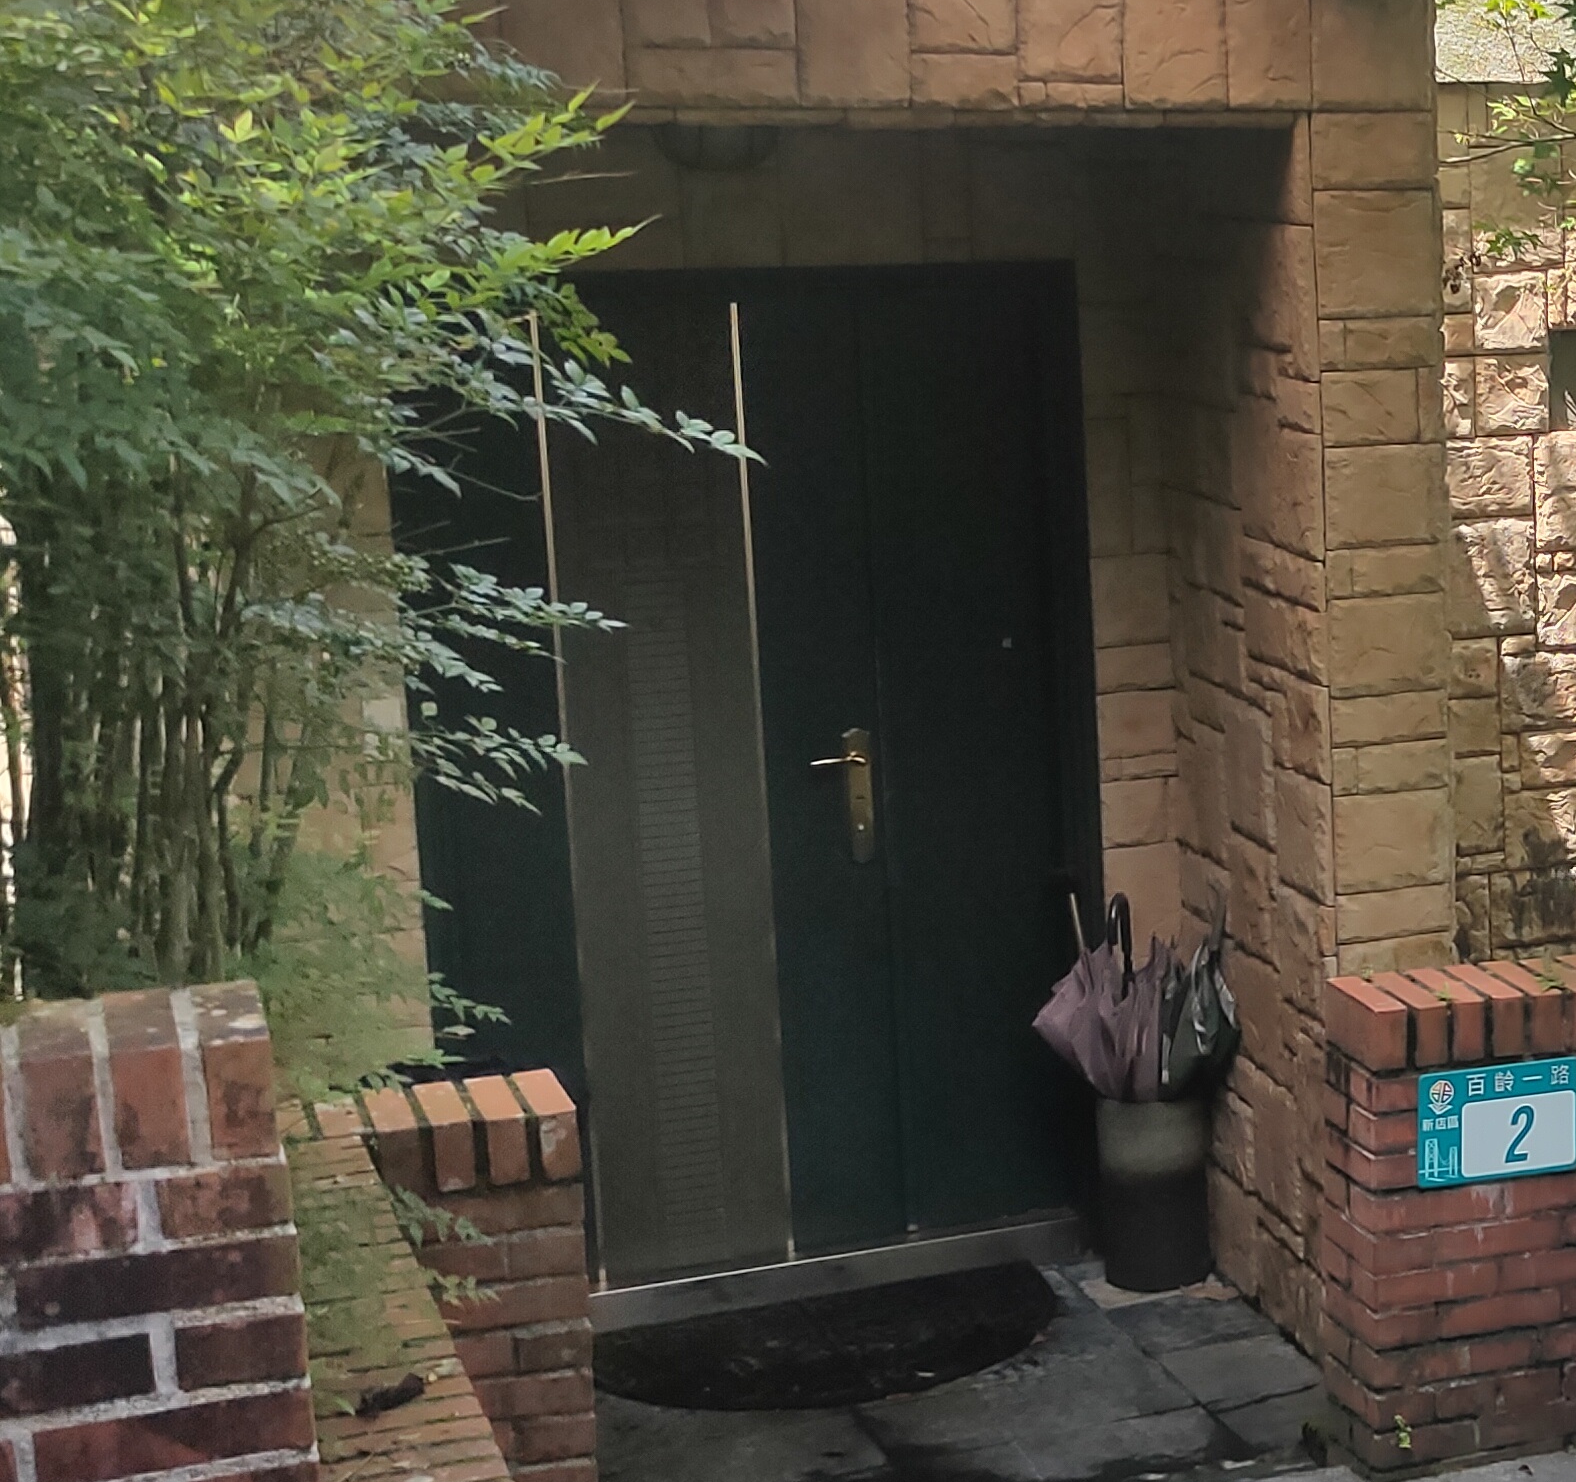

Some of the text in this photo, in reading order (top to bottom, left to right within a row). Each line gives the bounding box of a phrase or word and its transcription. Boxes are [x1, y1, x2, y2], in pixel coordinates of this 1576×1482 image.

[1466, 1064, 1570, 1097] 百齡一路
[1422, 1115, 1460, 1132] 新店區
[1504, 1104, 1535, 1165] 2
